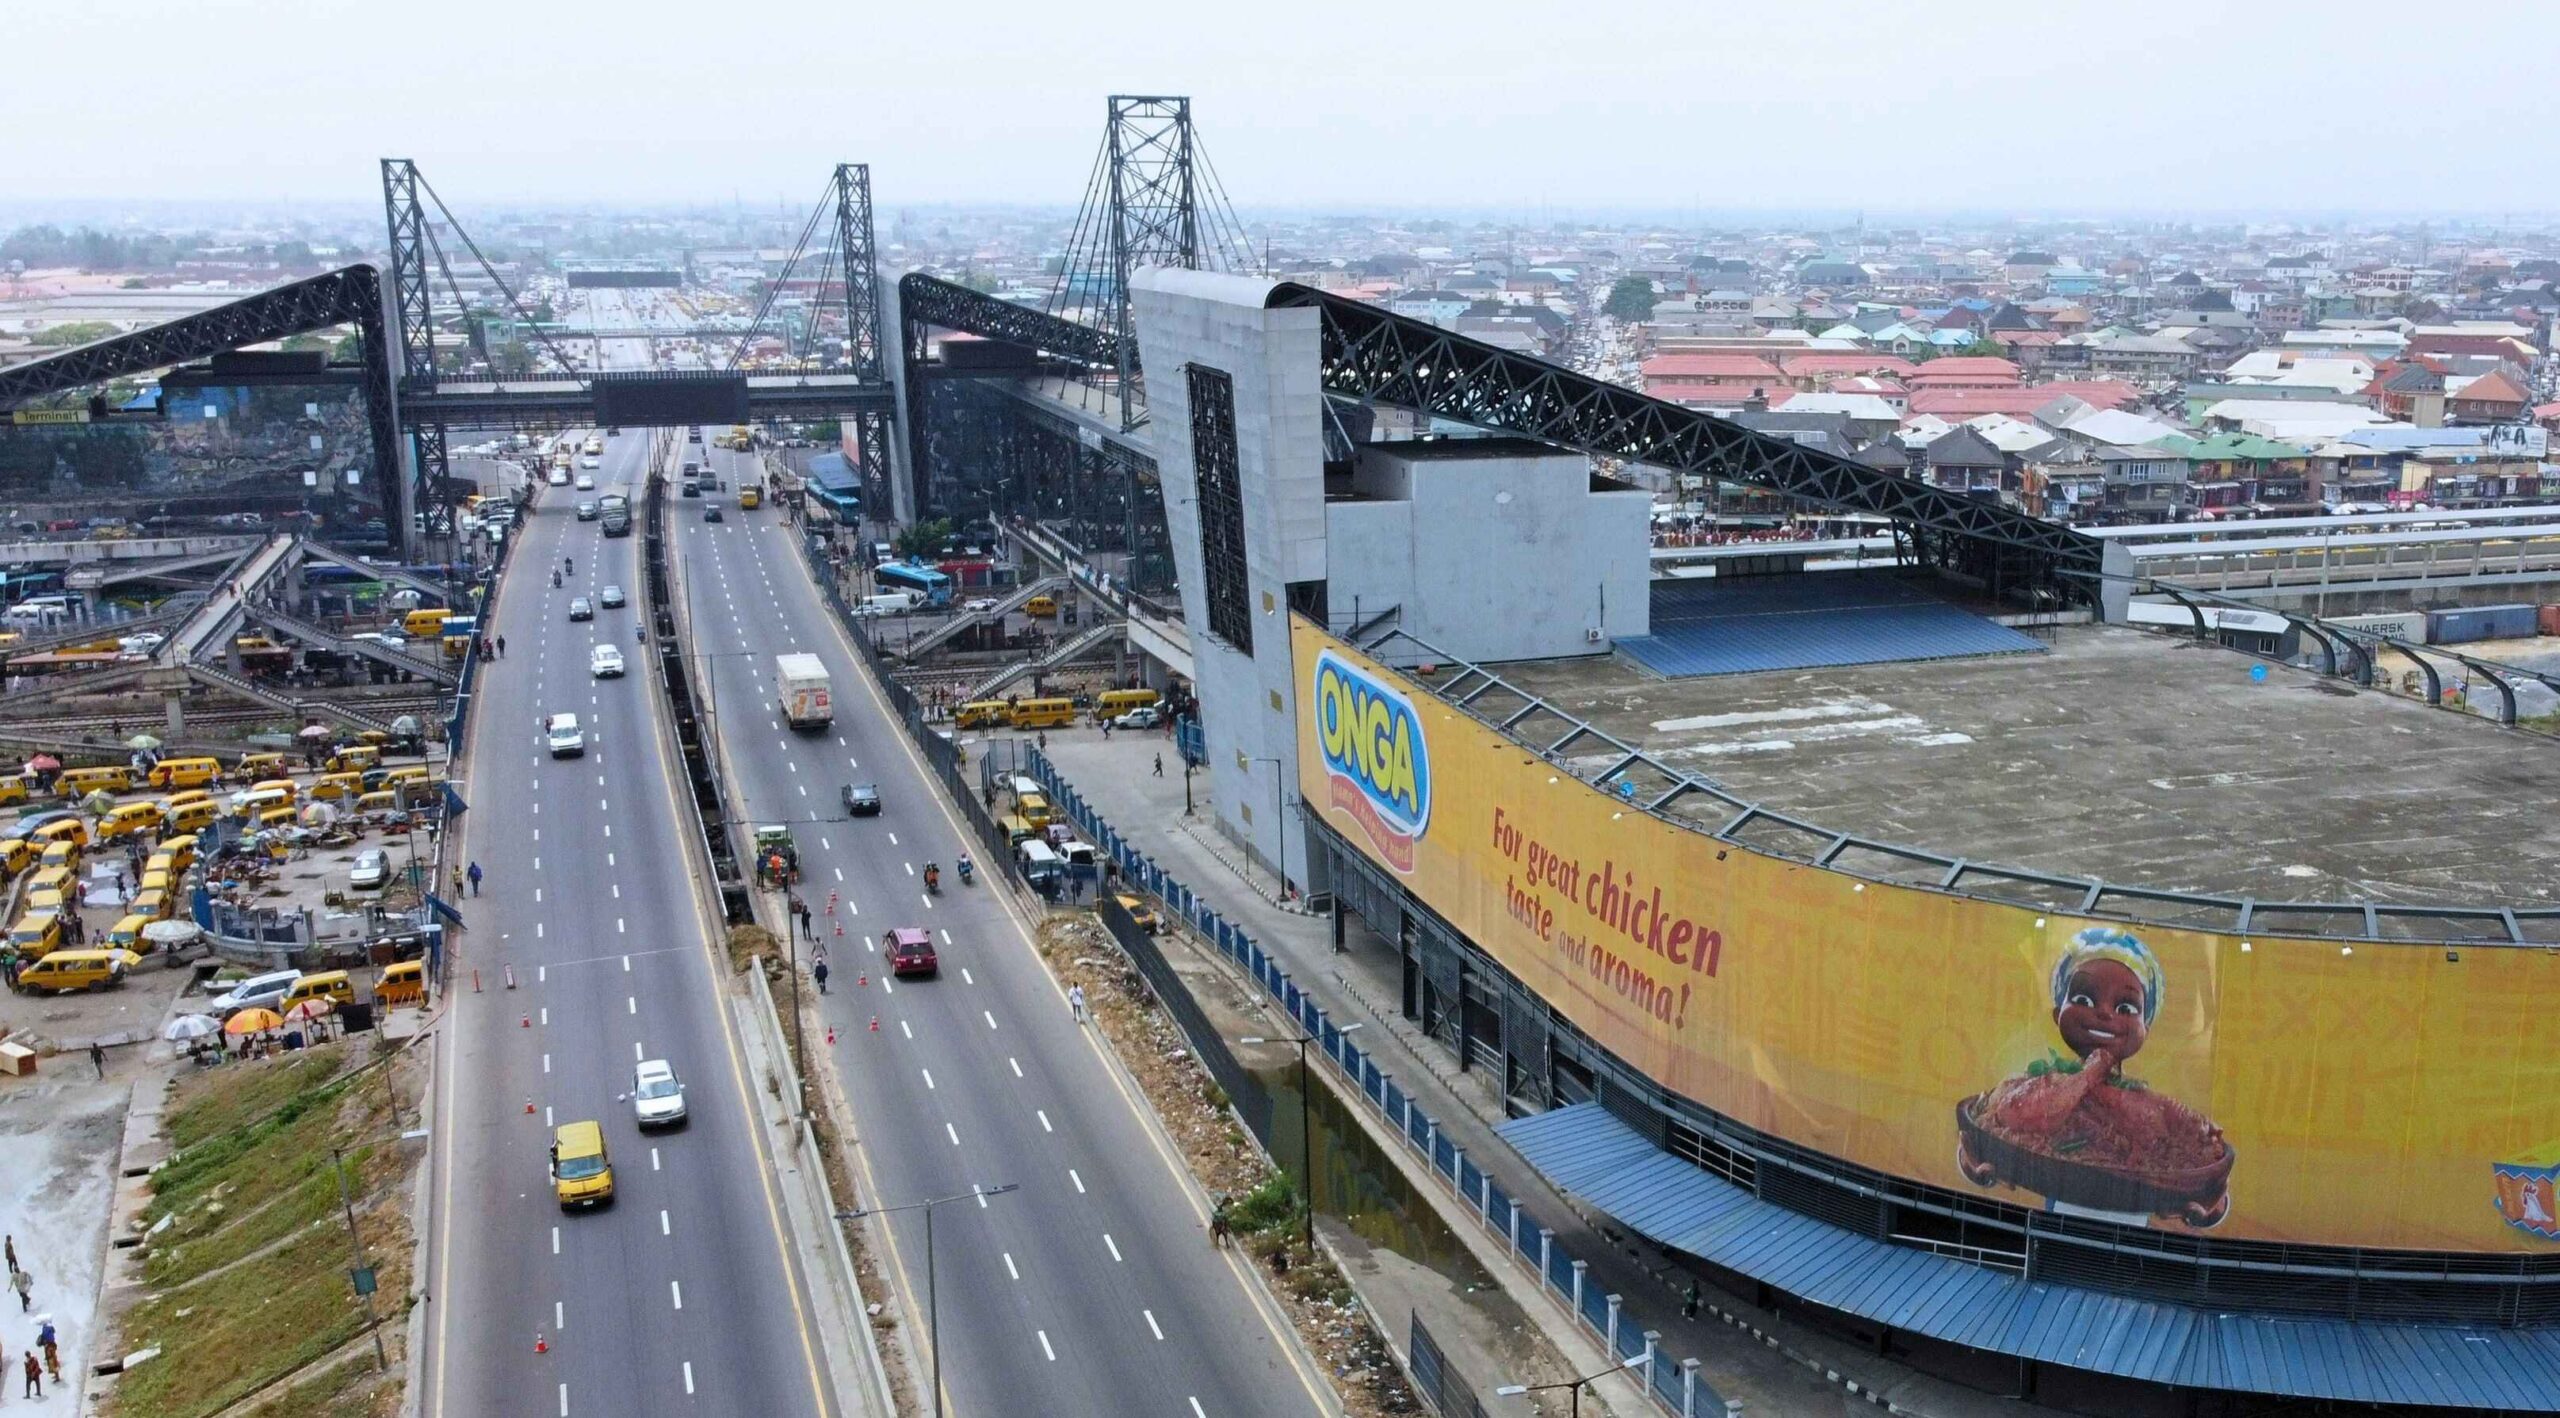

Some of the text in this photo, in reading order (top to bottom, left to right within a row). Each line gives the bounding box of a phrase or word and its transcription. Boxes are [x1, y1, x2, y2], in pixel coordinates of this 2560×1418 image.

[1321, 669, 1418, 814] ONGA
[1493, 807, 1722, 977] For great chicken
[1507, 875, 1691, 1031] taste and aroma!
